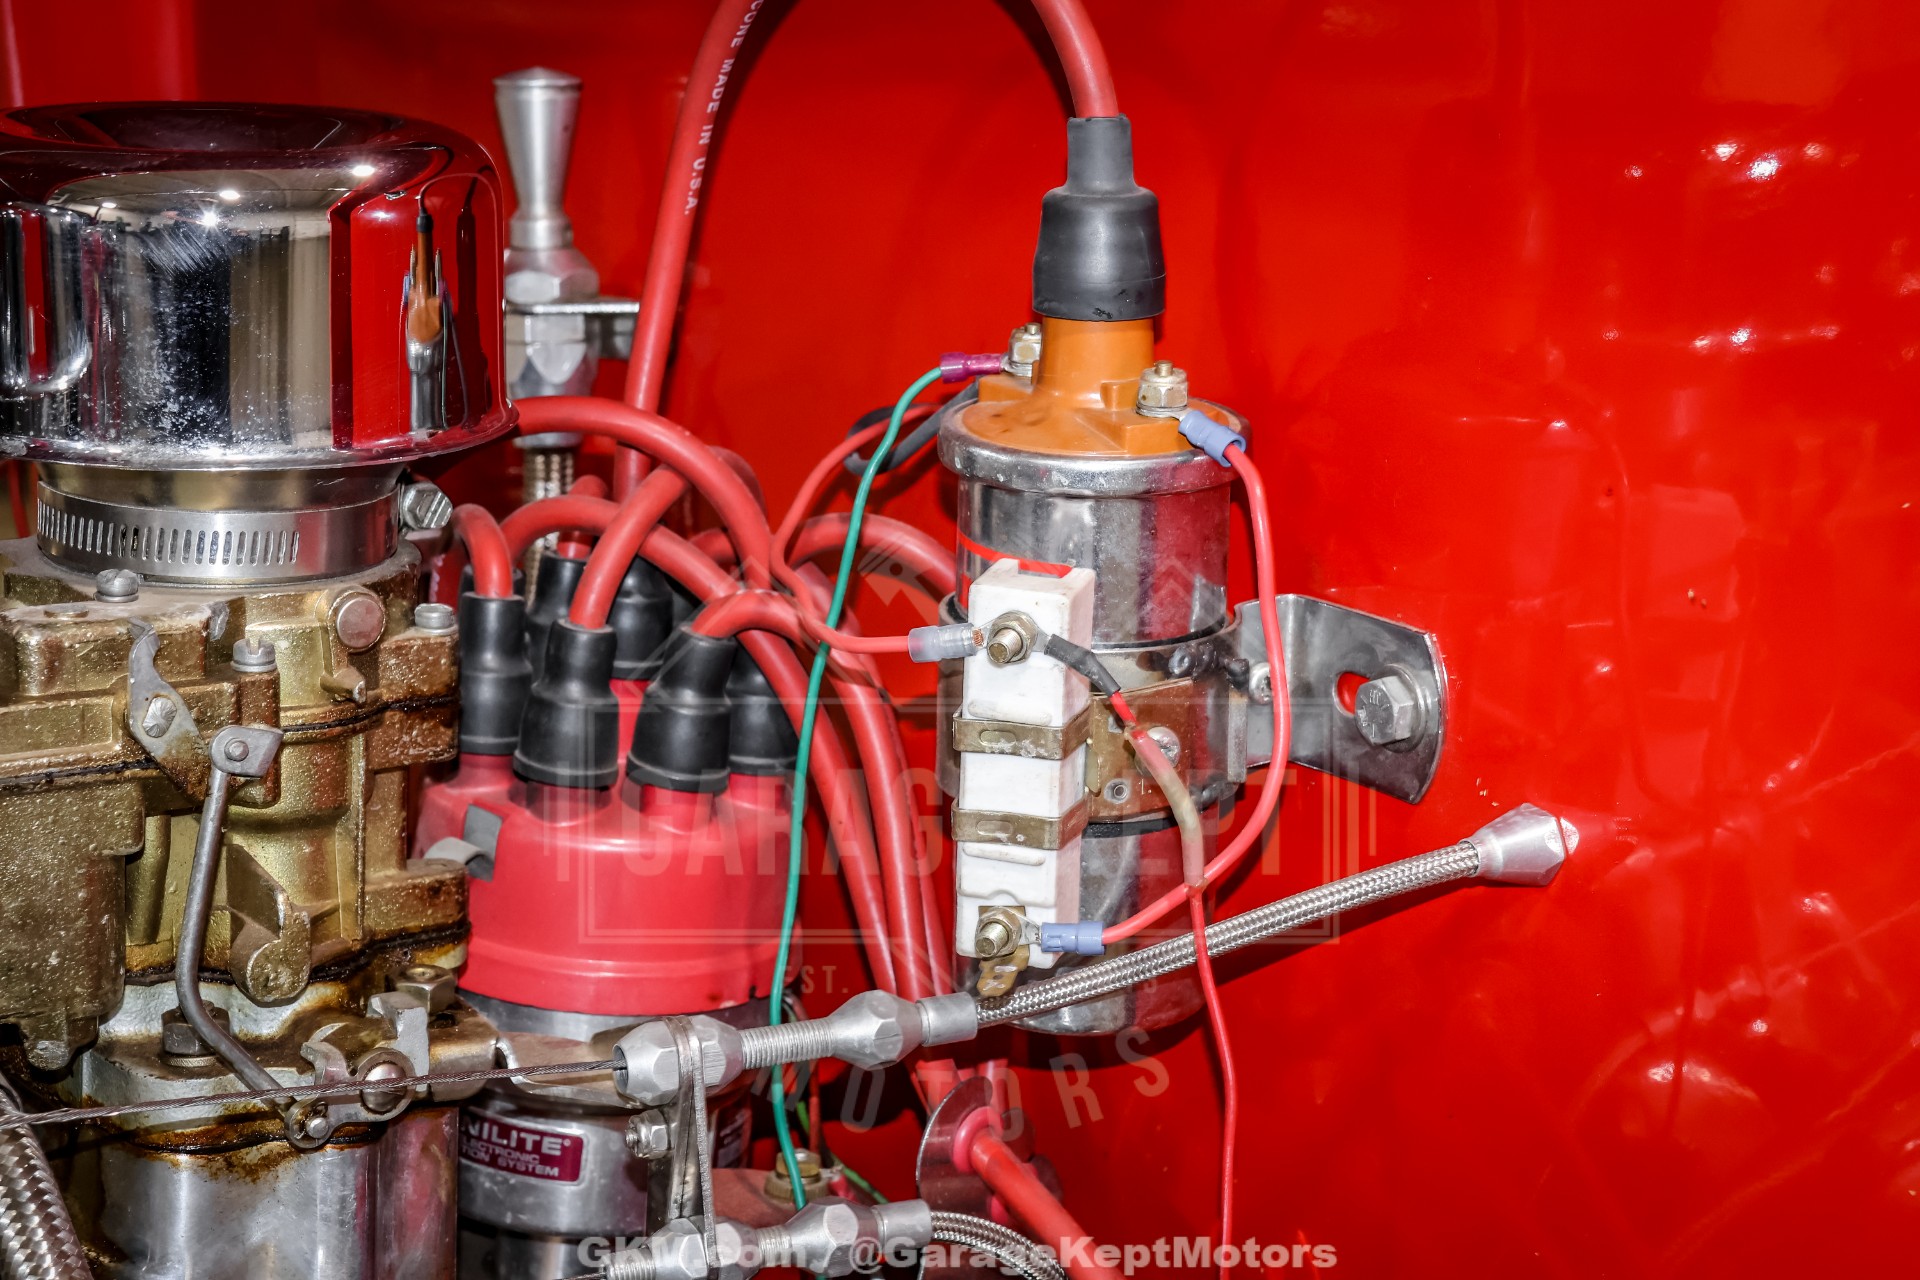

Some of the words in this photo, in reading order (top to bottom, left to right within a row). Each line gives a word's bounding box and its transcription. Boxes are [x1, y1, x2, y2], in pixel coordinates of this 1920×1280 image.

[706, 58, 735, 114] MADE
[698, 124, 714, 145] IN
[684, 157, 706, 215] U.S.A.
[497, 1156, 559, 1178] SYSTEM
